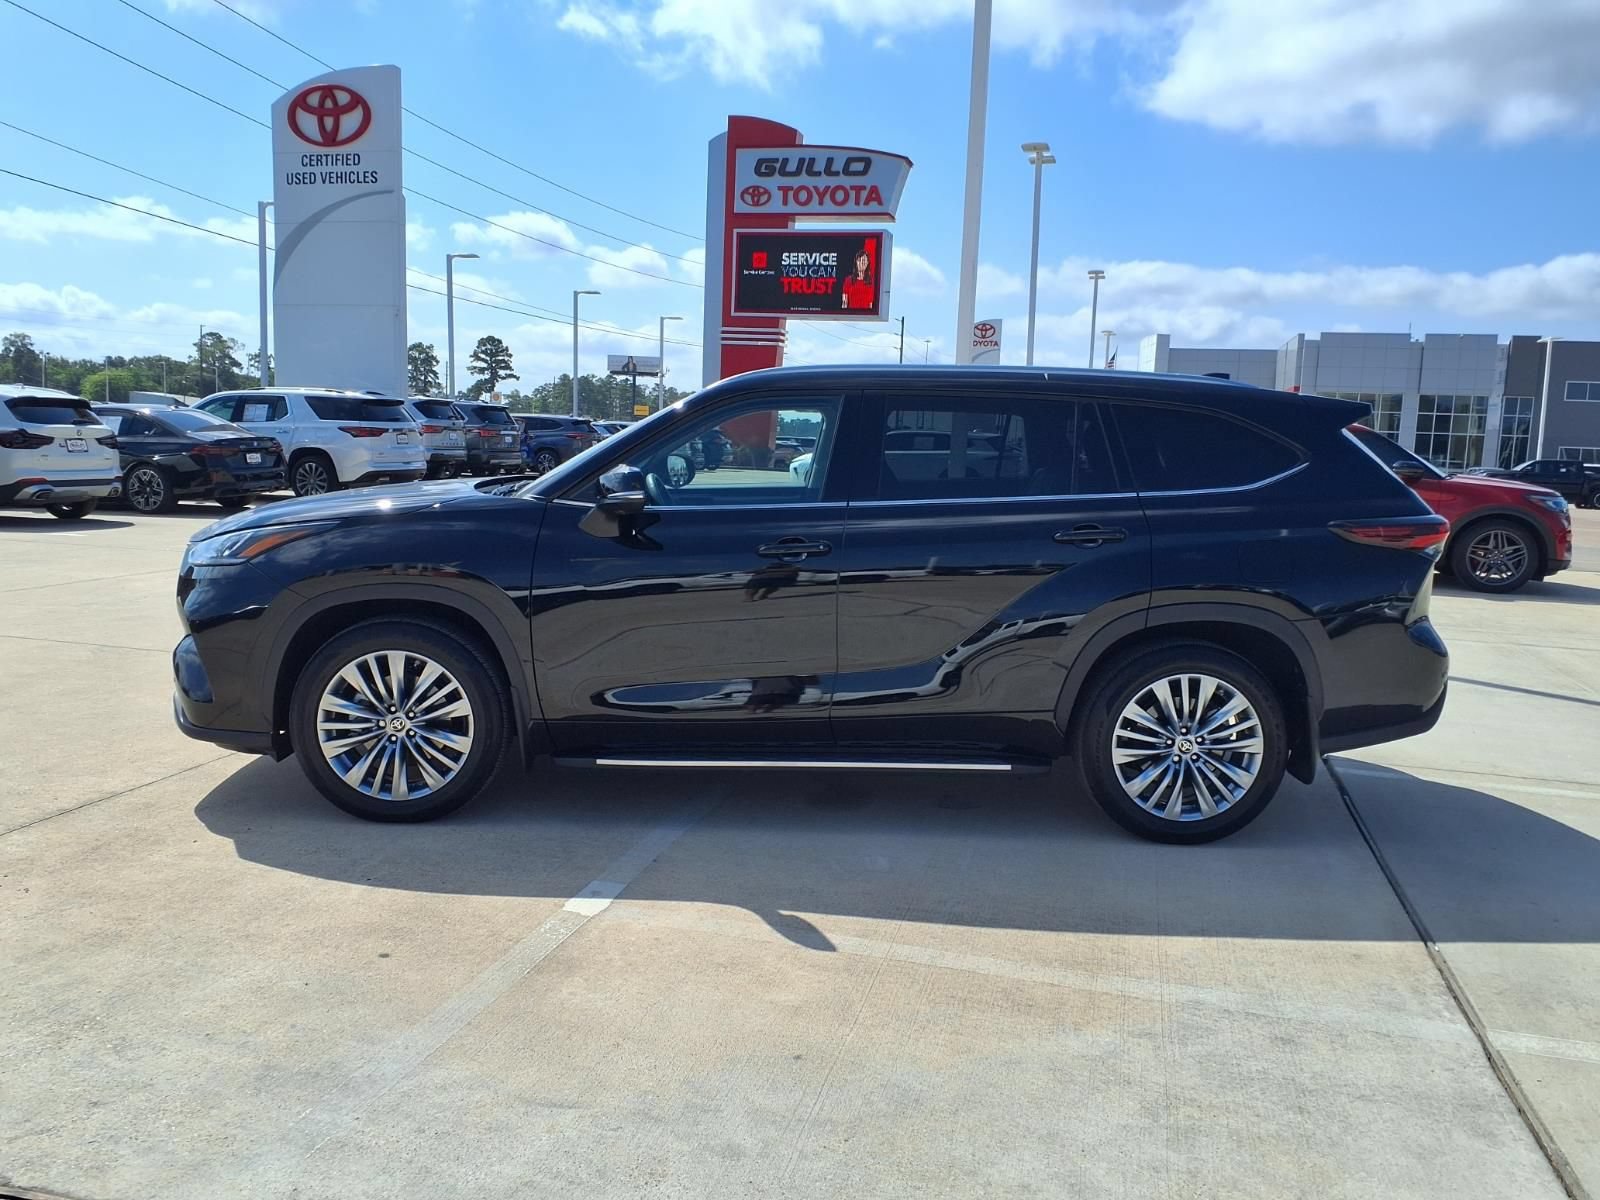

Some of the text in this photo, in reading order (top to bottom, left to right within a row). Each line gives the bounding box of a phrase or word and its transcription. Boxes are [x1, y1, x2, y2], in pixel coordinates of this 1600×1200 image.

[301, 153, 361, 168] CERTIFIED
[754, 156, 872, 178] GULLO
[286, 170, 379, 186] USED VEHICLES
[777, 185, 884, 207] TOYOTA
[781, 252, 838, 266] SERVICE
[781, 265, 807, 278] YOU
[808, 265, 836, 278] CAN
[780, 277, 837, 294] TRUST
[973, 340, 999, 348] OYOTA
